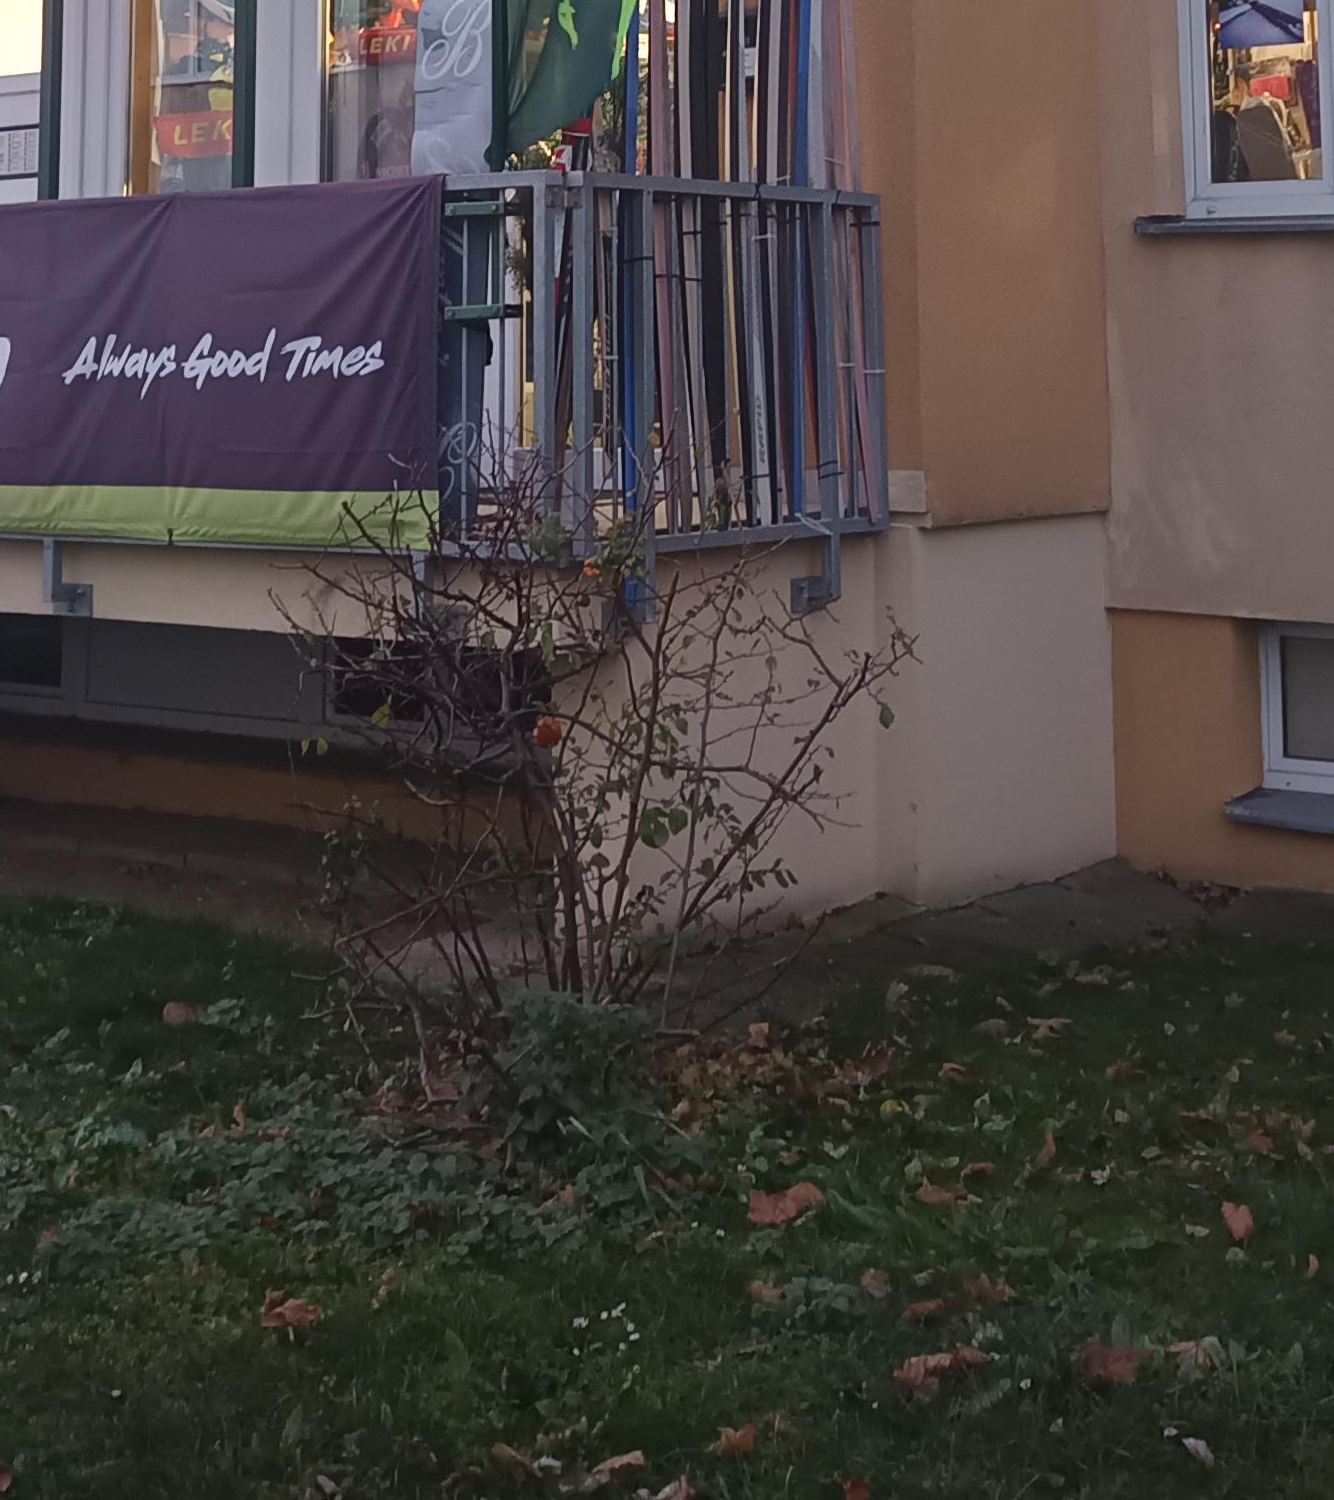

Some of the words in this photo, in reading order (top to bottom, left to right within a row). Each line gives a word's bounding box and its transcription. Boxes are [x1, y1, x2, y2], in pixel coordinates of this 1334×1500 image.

[359, 34, 411, 55] LEKI
[61, 333, 177, 401] Always
[181, 326, 277, 391] Good
[280, 336, 385, 382] Times
